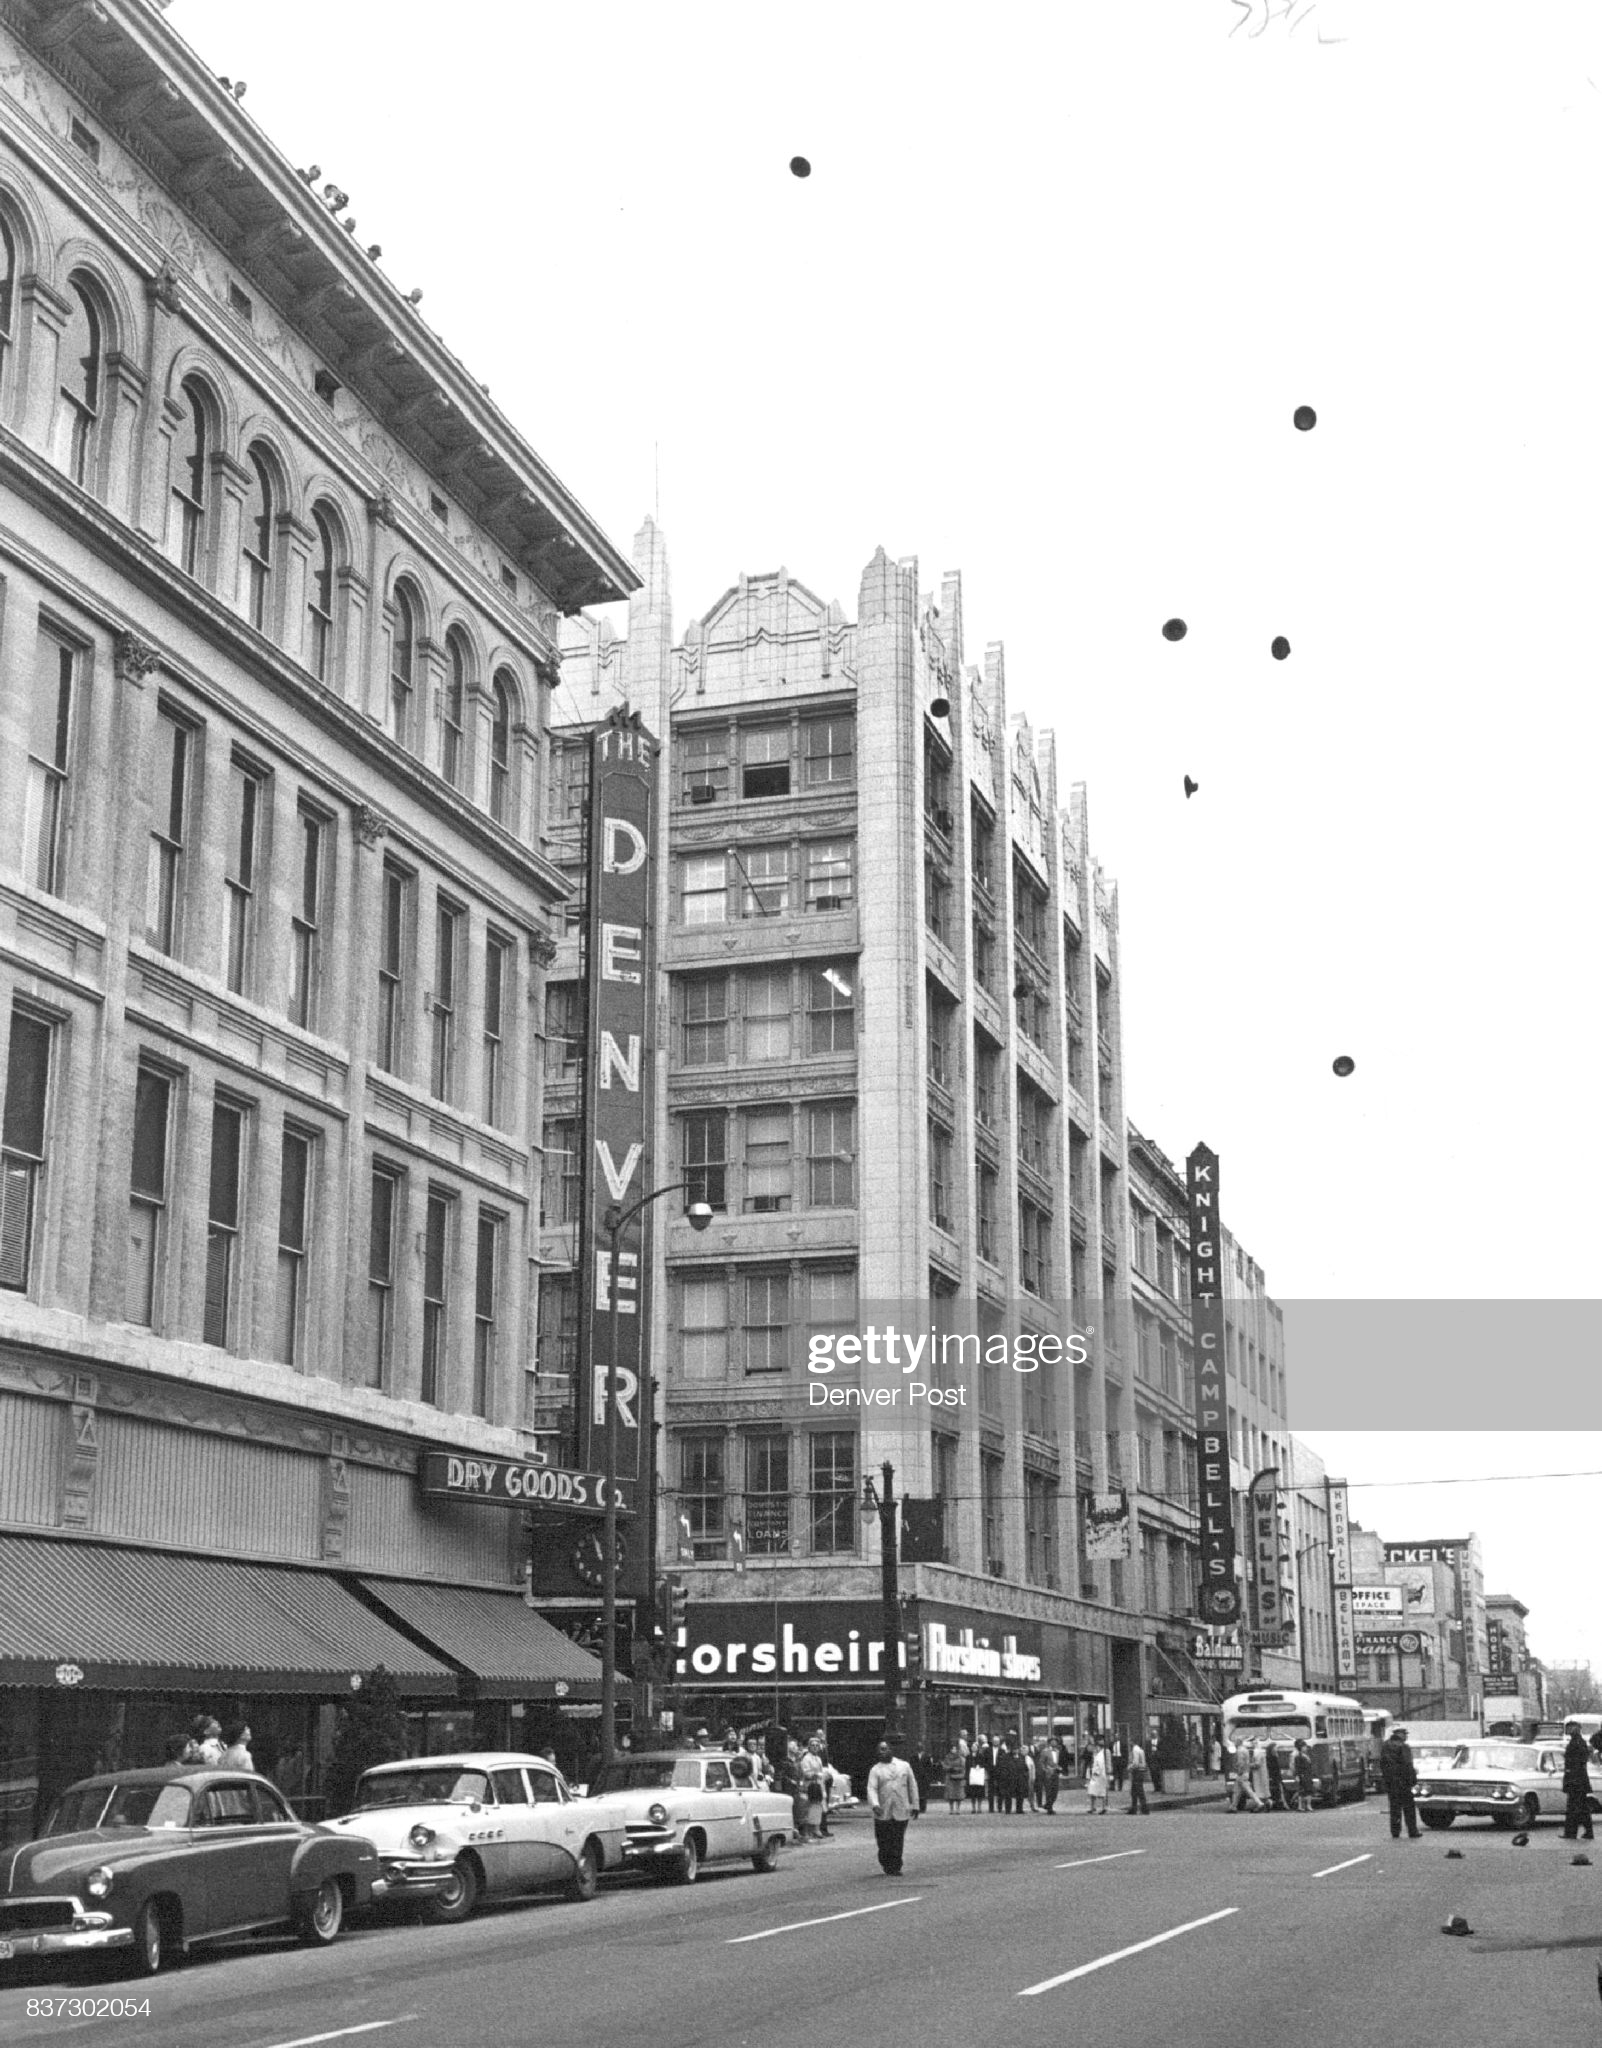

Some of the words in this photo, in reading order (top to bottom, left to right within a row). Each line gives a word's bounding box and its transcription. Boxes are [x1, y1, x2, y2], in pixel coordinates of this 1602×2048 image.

[597, 729, 651, 769] THE
[594, 817, 648, 1428] DENVER
[1194, 1165, 1215, 1309] KNIGHT
[1200, 1332, 1226, 1576] CAMPBELL'S
[447, 1457, 497, 1493] DRY
[505, 1466, 587, 1504] GOODS
[1254, 1493, 1276, 1610] WELLS
[1351, 1591, 1391, 1600] OFFICE
[1252, 1631, 1290, 1644] MUSIC
[1356, 1636, 1399, 1644] FINANCE
